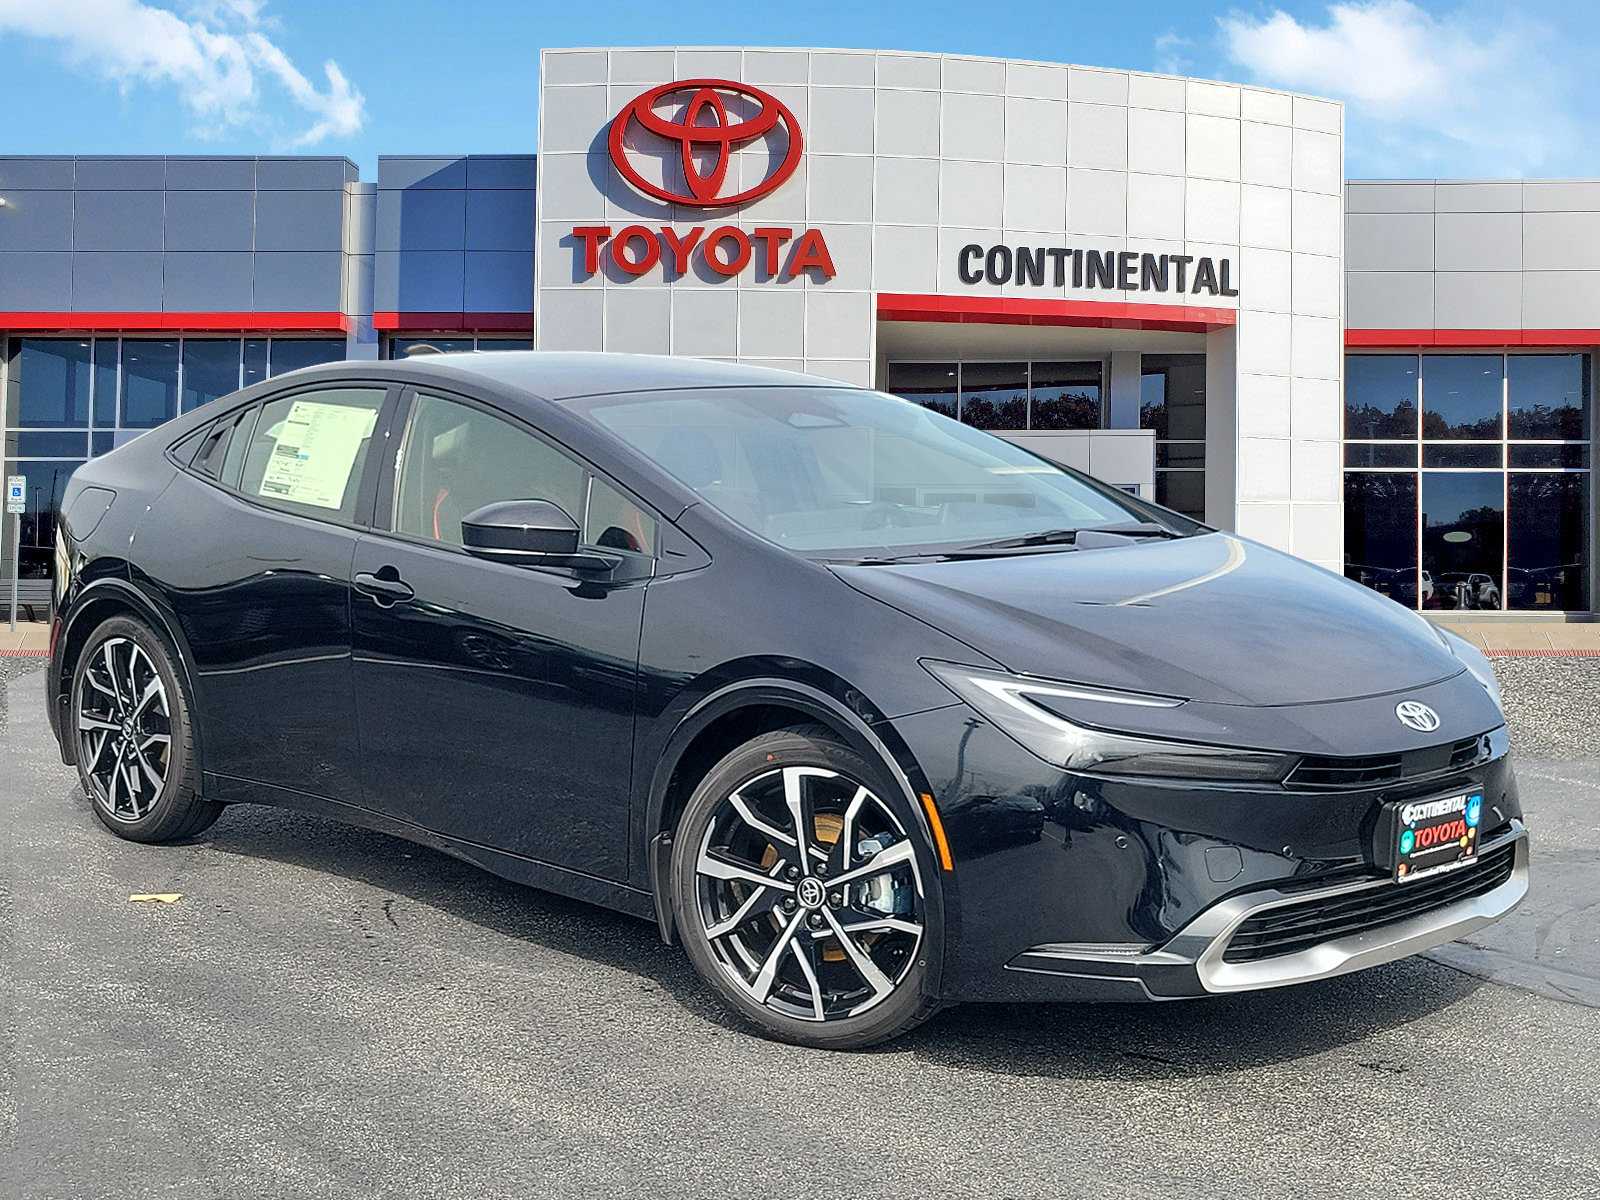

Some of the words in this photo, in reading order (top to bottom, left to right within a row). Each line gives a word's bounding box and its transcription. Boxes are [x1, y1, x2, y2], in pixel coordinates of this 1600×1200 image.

[573, 225, 836, 277] TOYOTA
[959, 244, 1239, 296] CONTINENTAL
[1414, 819, 1467, 848] TOYOTA
